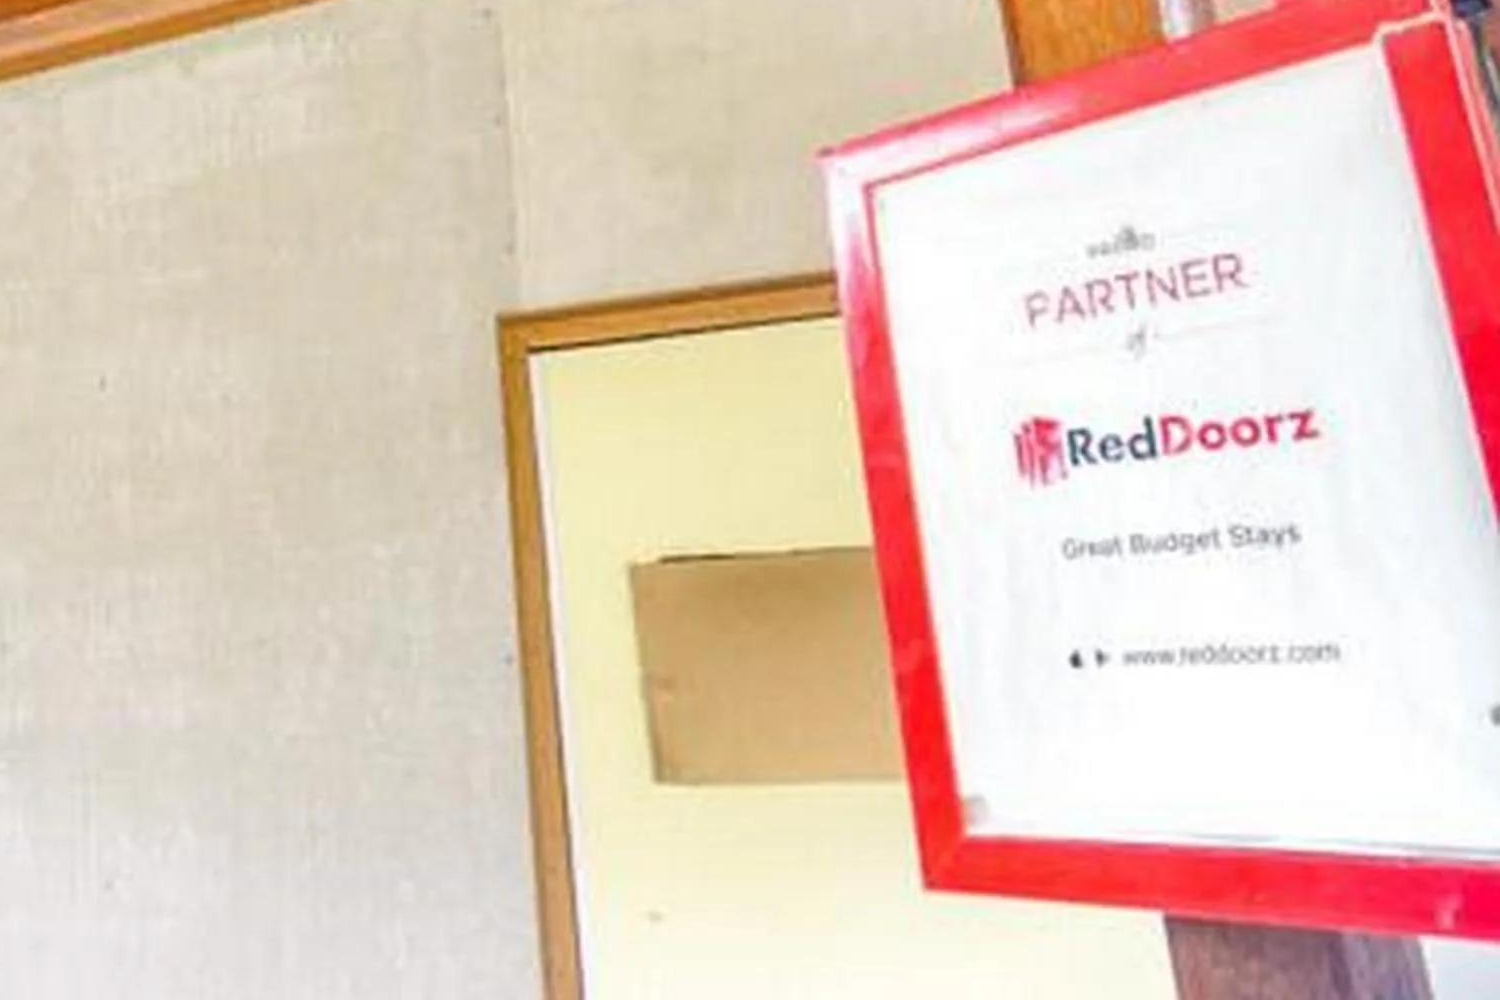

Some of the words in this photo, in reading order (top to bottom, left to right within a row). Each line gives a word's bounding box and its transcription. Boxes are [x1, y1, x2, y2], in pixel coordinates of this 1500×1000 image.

[1023, 252, 1250, 330] PARTNER
[1065, 407, 1321, 467] RedDoorz
[1060, 535, 1124, 561] Great
[1129, 528, 1221, 556] Budget
[1227, 522, 1303, 549] Stays
